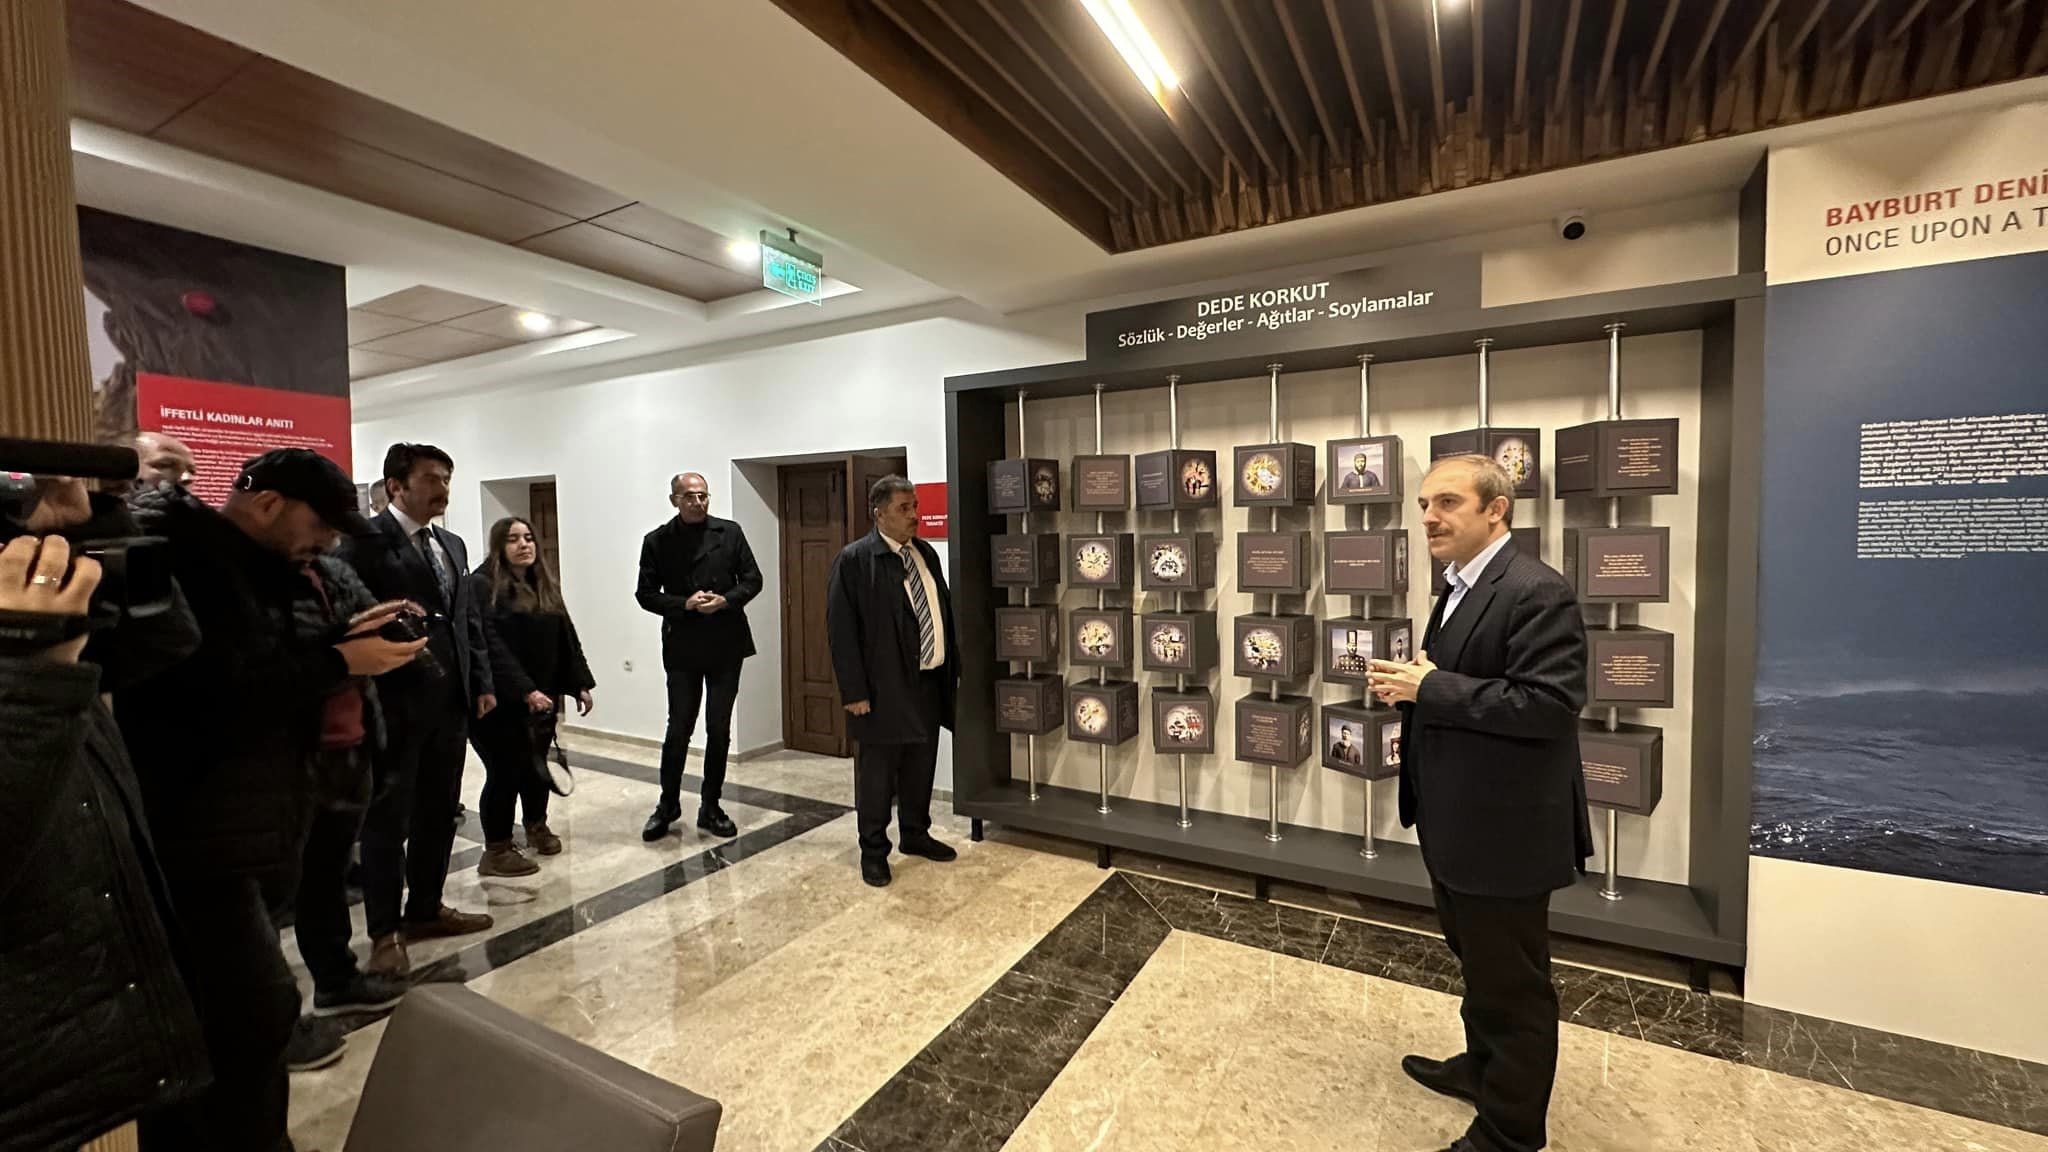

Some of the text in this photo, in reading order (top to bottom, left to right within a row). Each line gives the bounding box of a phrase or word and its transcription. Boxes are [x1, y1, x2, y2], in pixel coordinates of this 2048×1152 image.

[1826, 187, 1963, 227] BAYBURT
[1826, 227, 1900, 256] ONCE
[1911, 214, 1992, 244] UPON
[2001, 210, 2023, 232] A
[1118, 327, 1166, 348] Sözlük
[1176, 317, 1245, 340] Değerler
[1256, 307, 1315, 330] Ağıtlar
[1328, 290, 1434, 319] Soylamalar
[1198, 282, 1329, 317] DEDE KORKUT
[160, 406, 294, 430] İFFETLİ KADINLAR ANITI
